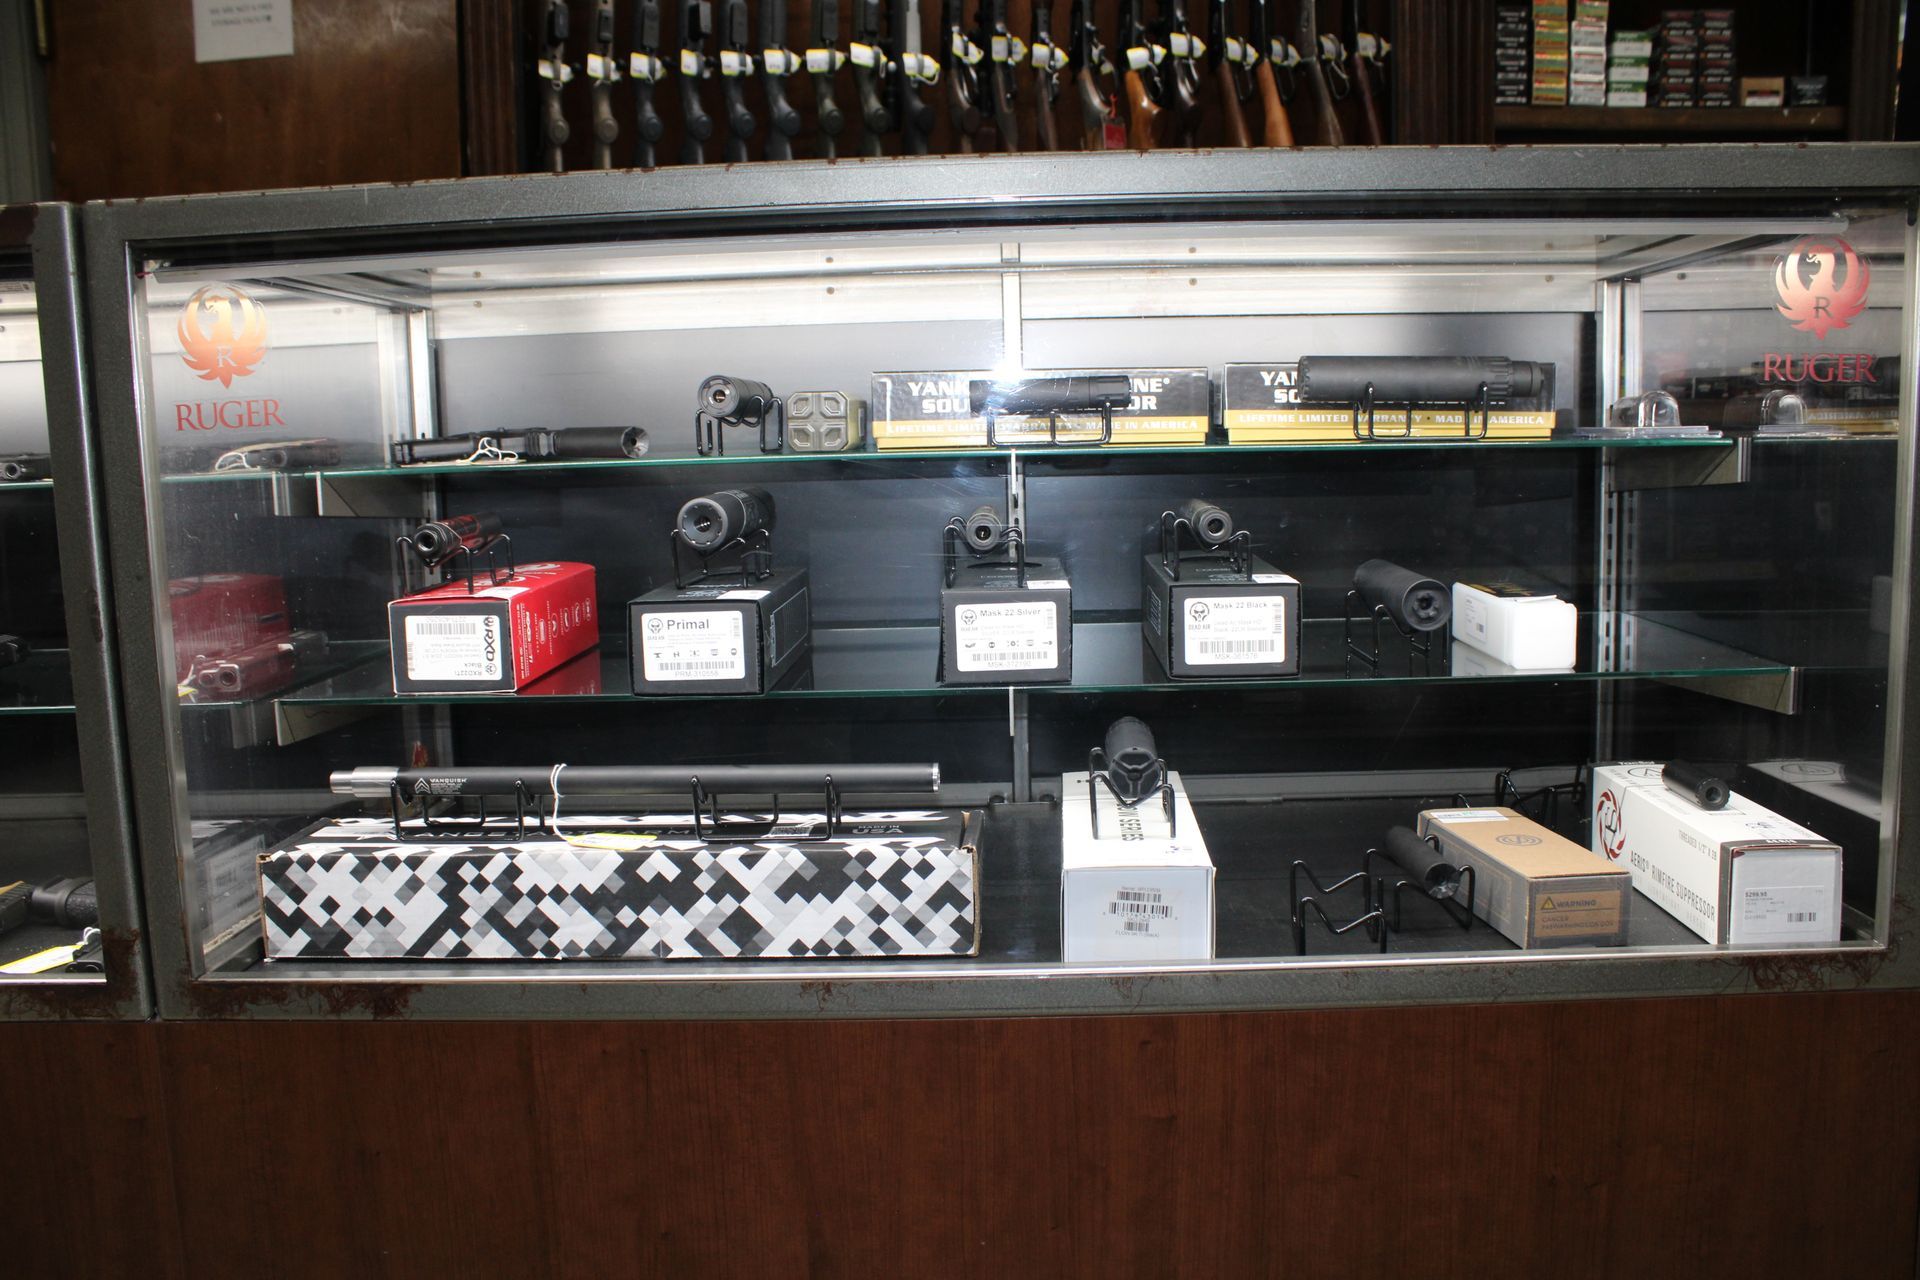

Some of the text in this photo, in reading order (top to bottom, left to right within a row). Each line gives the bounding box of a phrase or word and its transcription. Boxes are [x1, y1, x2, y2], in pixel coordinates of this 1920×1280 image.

[1763, 352, 1877, 382] RUGER
[175, 399, 287, 431] RUGER
[1240, 414, 1295, 423] LIFETIME
[1299, 414, 1349, 423] LIMITED
[1489, 415, 1545, 425] AMERICA
[1142, 420, 1198, 430] AMERICA
[1235, 601, 1245, 609] 22
[1246, 601, 1267, 609] Black
[979, 609, 1002, 617] Mask
[1017, 608, 1041, 616] Silver
[666, 618, 709, 630] Primal
[484, 628, 496, 662] RXD
[1651, 864, 1675, 894] RIMFIRE
[1675, 882, 1716, 923] SUPPRESSOR
[1556, 899, 1597, 908] WARNING
